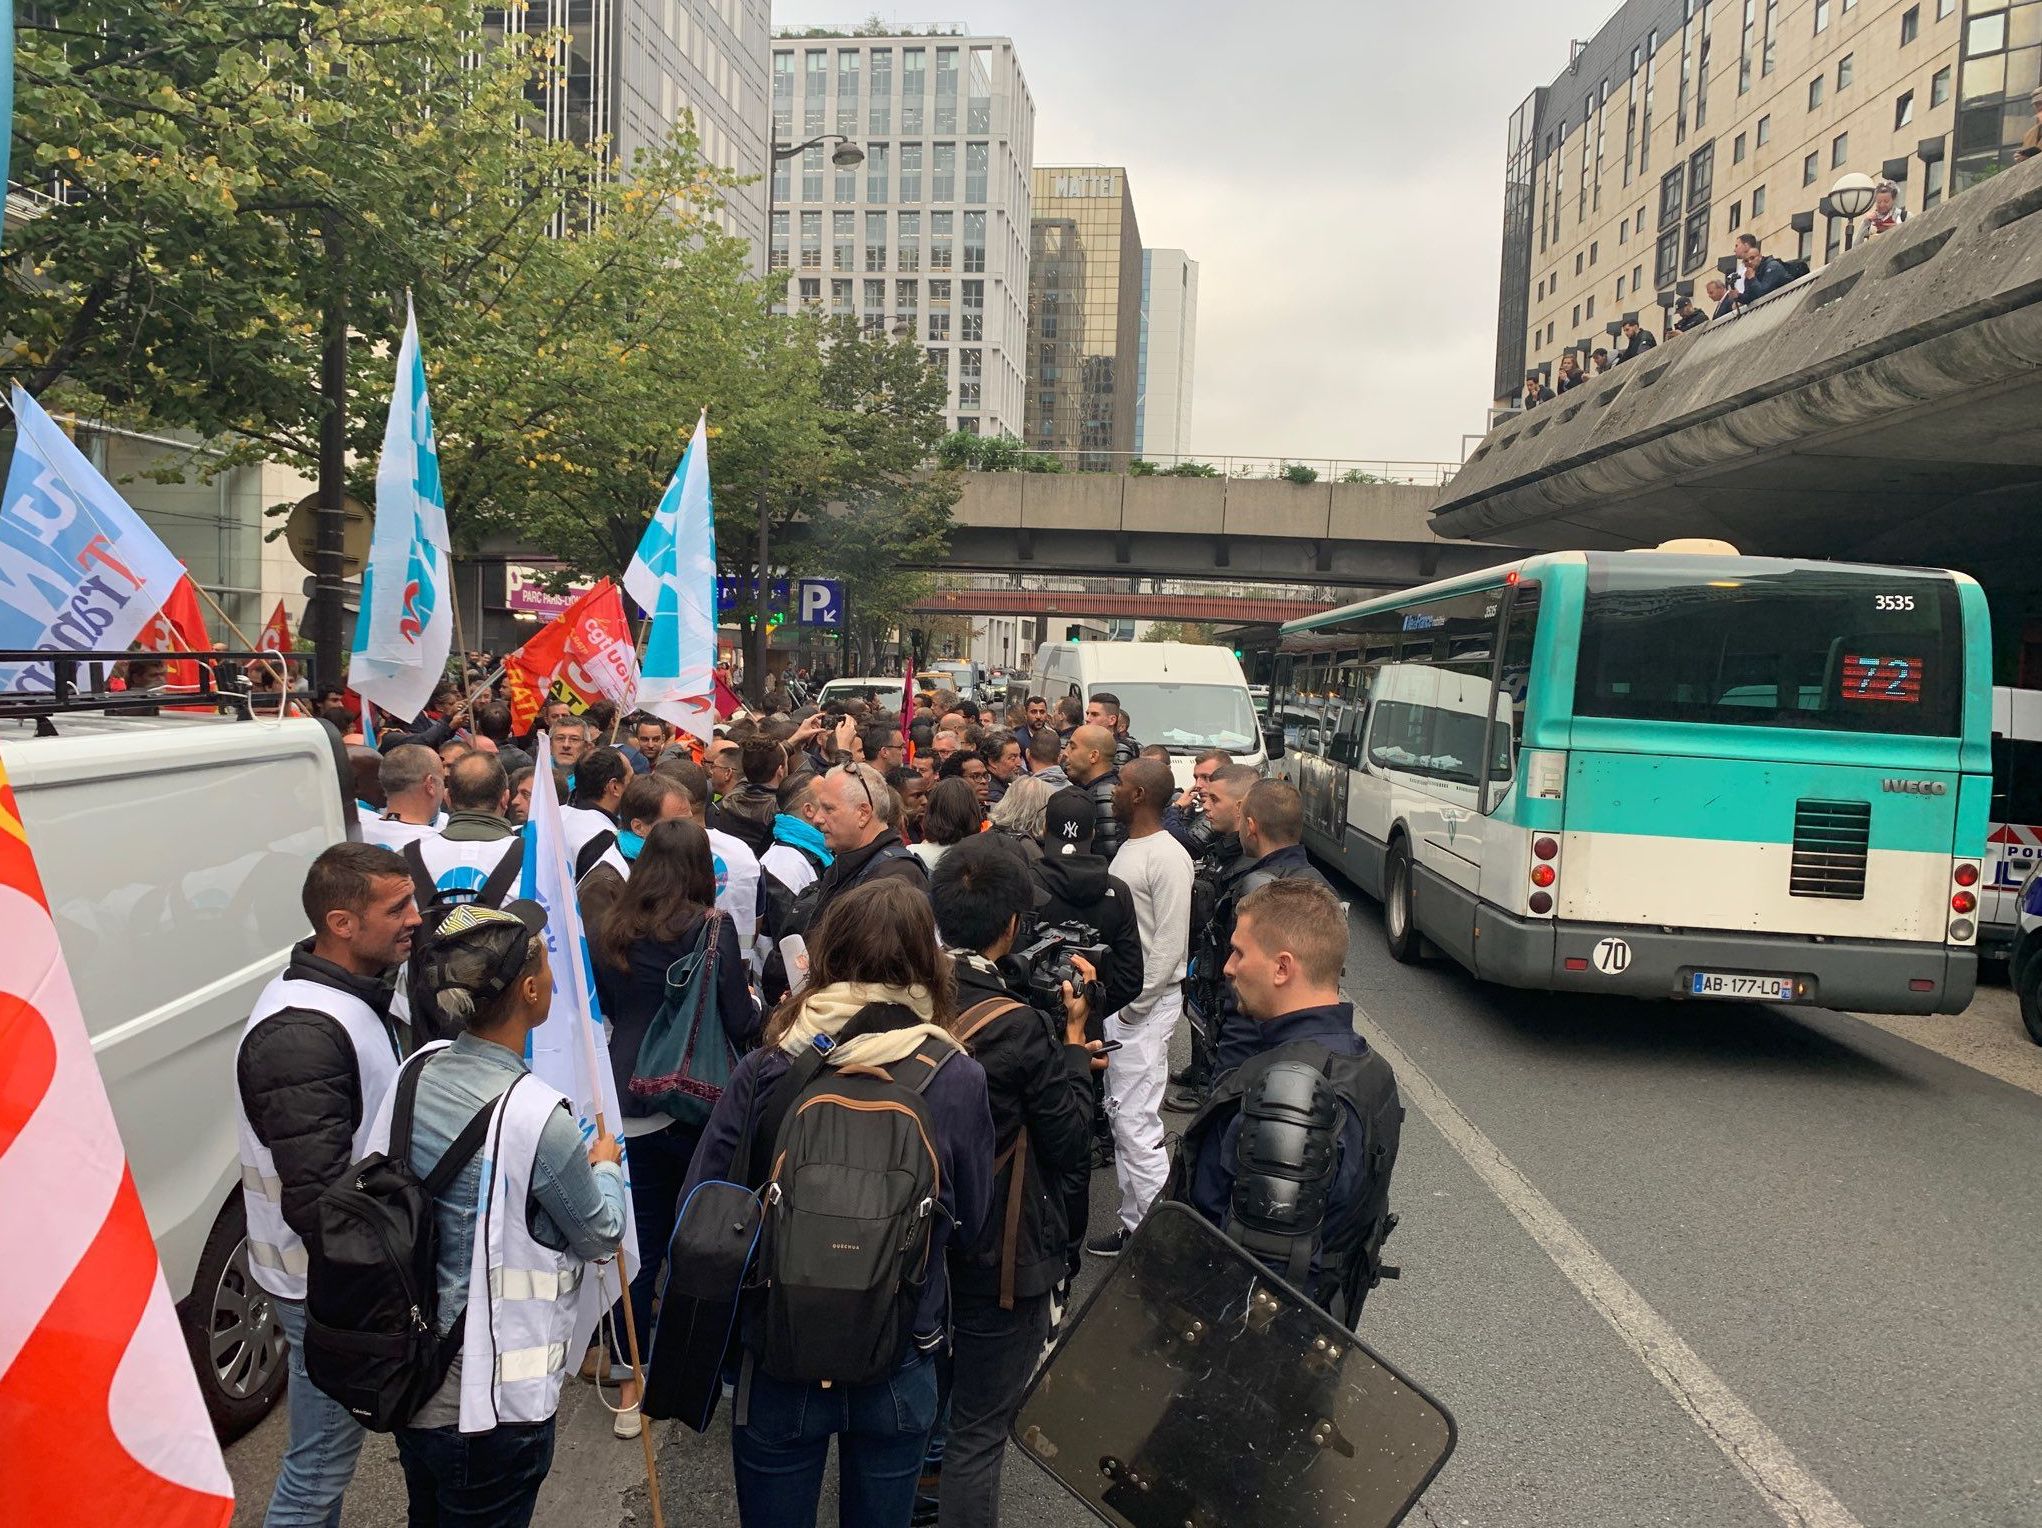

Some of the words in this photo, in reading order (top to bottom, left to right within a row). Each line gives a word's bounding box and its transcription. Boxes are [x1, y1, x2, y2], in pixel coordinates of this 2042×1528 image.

[522, 590, 542, 604] PARC
[802, 584, 831, 621] P
[1875, 595, 1915, 611] 3535
[584, 618, 614, 651] cgt
[1858, 658, 1909, 695] 72
[1883, 779, 1947, 795] IVECO
[1062, 820, 1079, 838] NY
[1601, 941, 1627, 970] 70
[1703, 976, 1780, 995] AB-177-LQ
